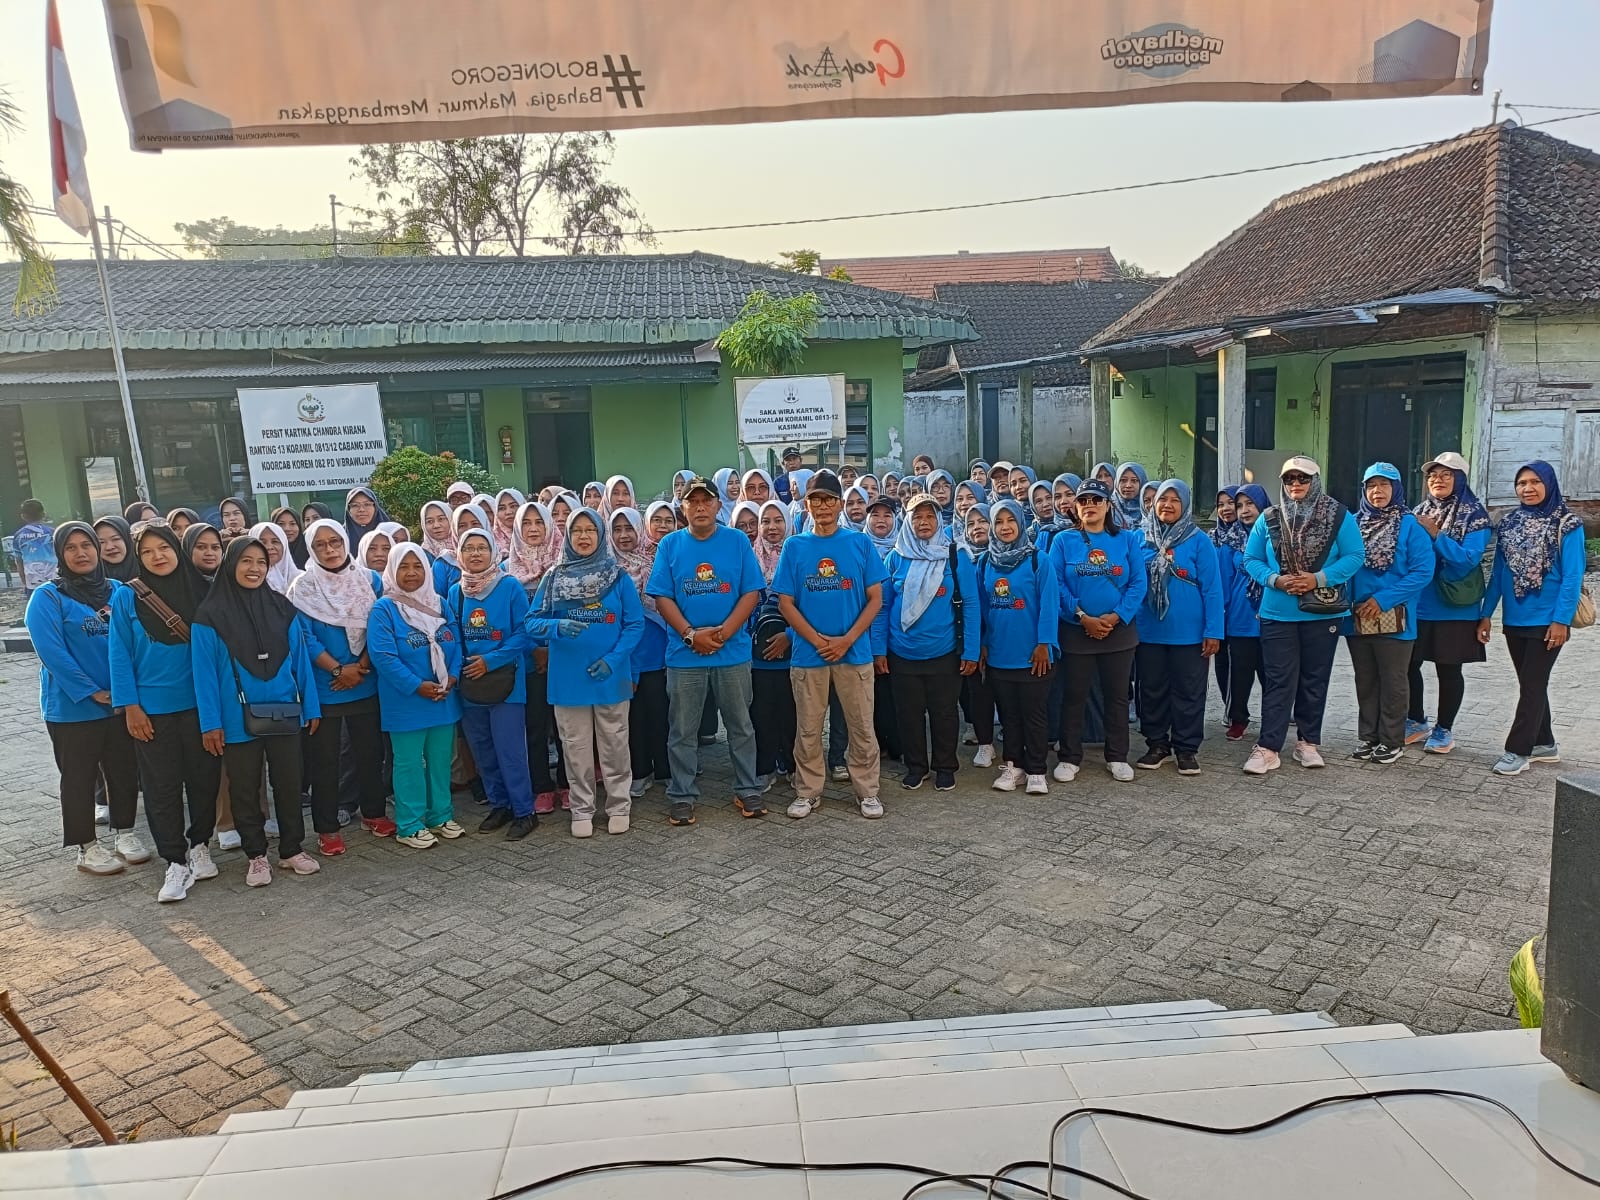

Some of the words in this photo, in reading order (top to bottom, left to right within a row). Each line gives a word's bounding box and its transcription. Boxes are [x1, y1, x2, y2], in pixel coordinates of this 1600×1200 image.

[785, 415, 814, 423] KORAMIL
[261, 429, 283, 439] PERSIT
[284, 427, 312, 438] KARTIKA
[312, 426, 342, 436] CHANDRA
[342, 425, 366, 435] KIRANA
[777, 423, 807, 431] KASIMAN
[249, 445, 277, 456] RANTING
[277, 445, 286, 454] 13
[286, 443, 314, 454] KORAMIL
[338, 440, 364, 451] CABANG
[261, 461, 291, 471] KOORCAB
[292, 459, 314, 470] KOREM
[314, 458, 326, 469] 082
[326, 458, 335, 468] PD
[266, 480, 306, 489] DIPONEGORO
[326, 478, 356, 486] BATOKAN
